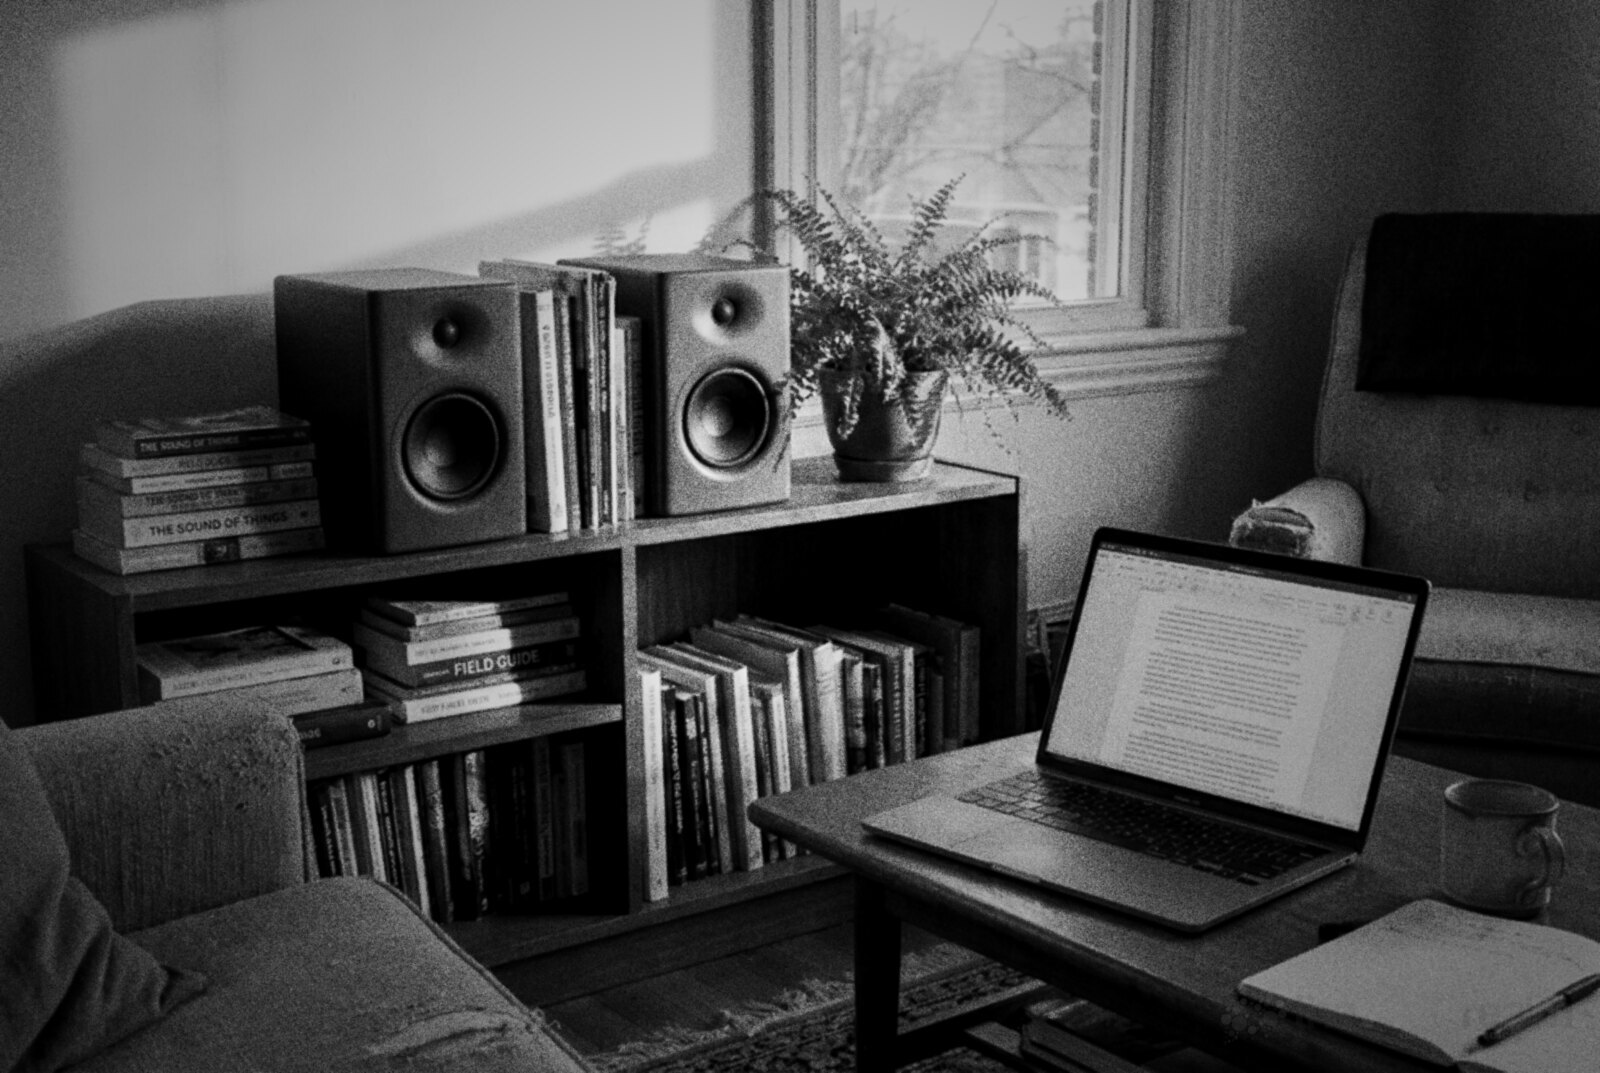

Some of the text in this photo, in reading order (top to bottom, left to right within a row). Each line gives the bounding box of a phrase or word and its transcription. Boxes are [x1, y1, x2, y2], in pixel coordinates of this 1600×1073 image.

[140, 442, 157, 452] THE
[159, 439, 191, 450] SOUND
[193, 437, 205, 447] OF
[150, 510, 288, 537] THE SOUND OF THINGS
[454, 657, 494, 677] FIELD
[496, 650, 540, 670] GUIDE
